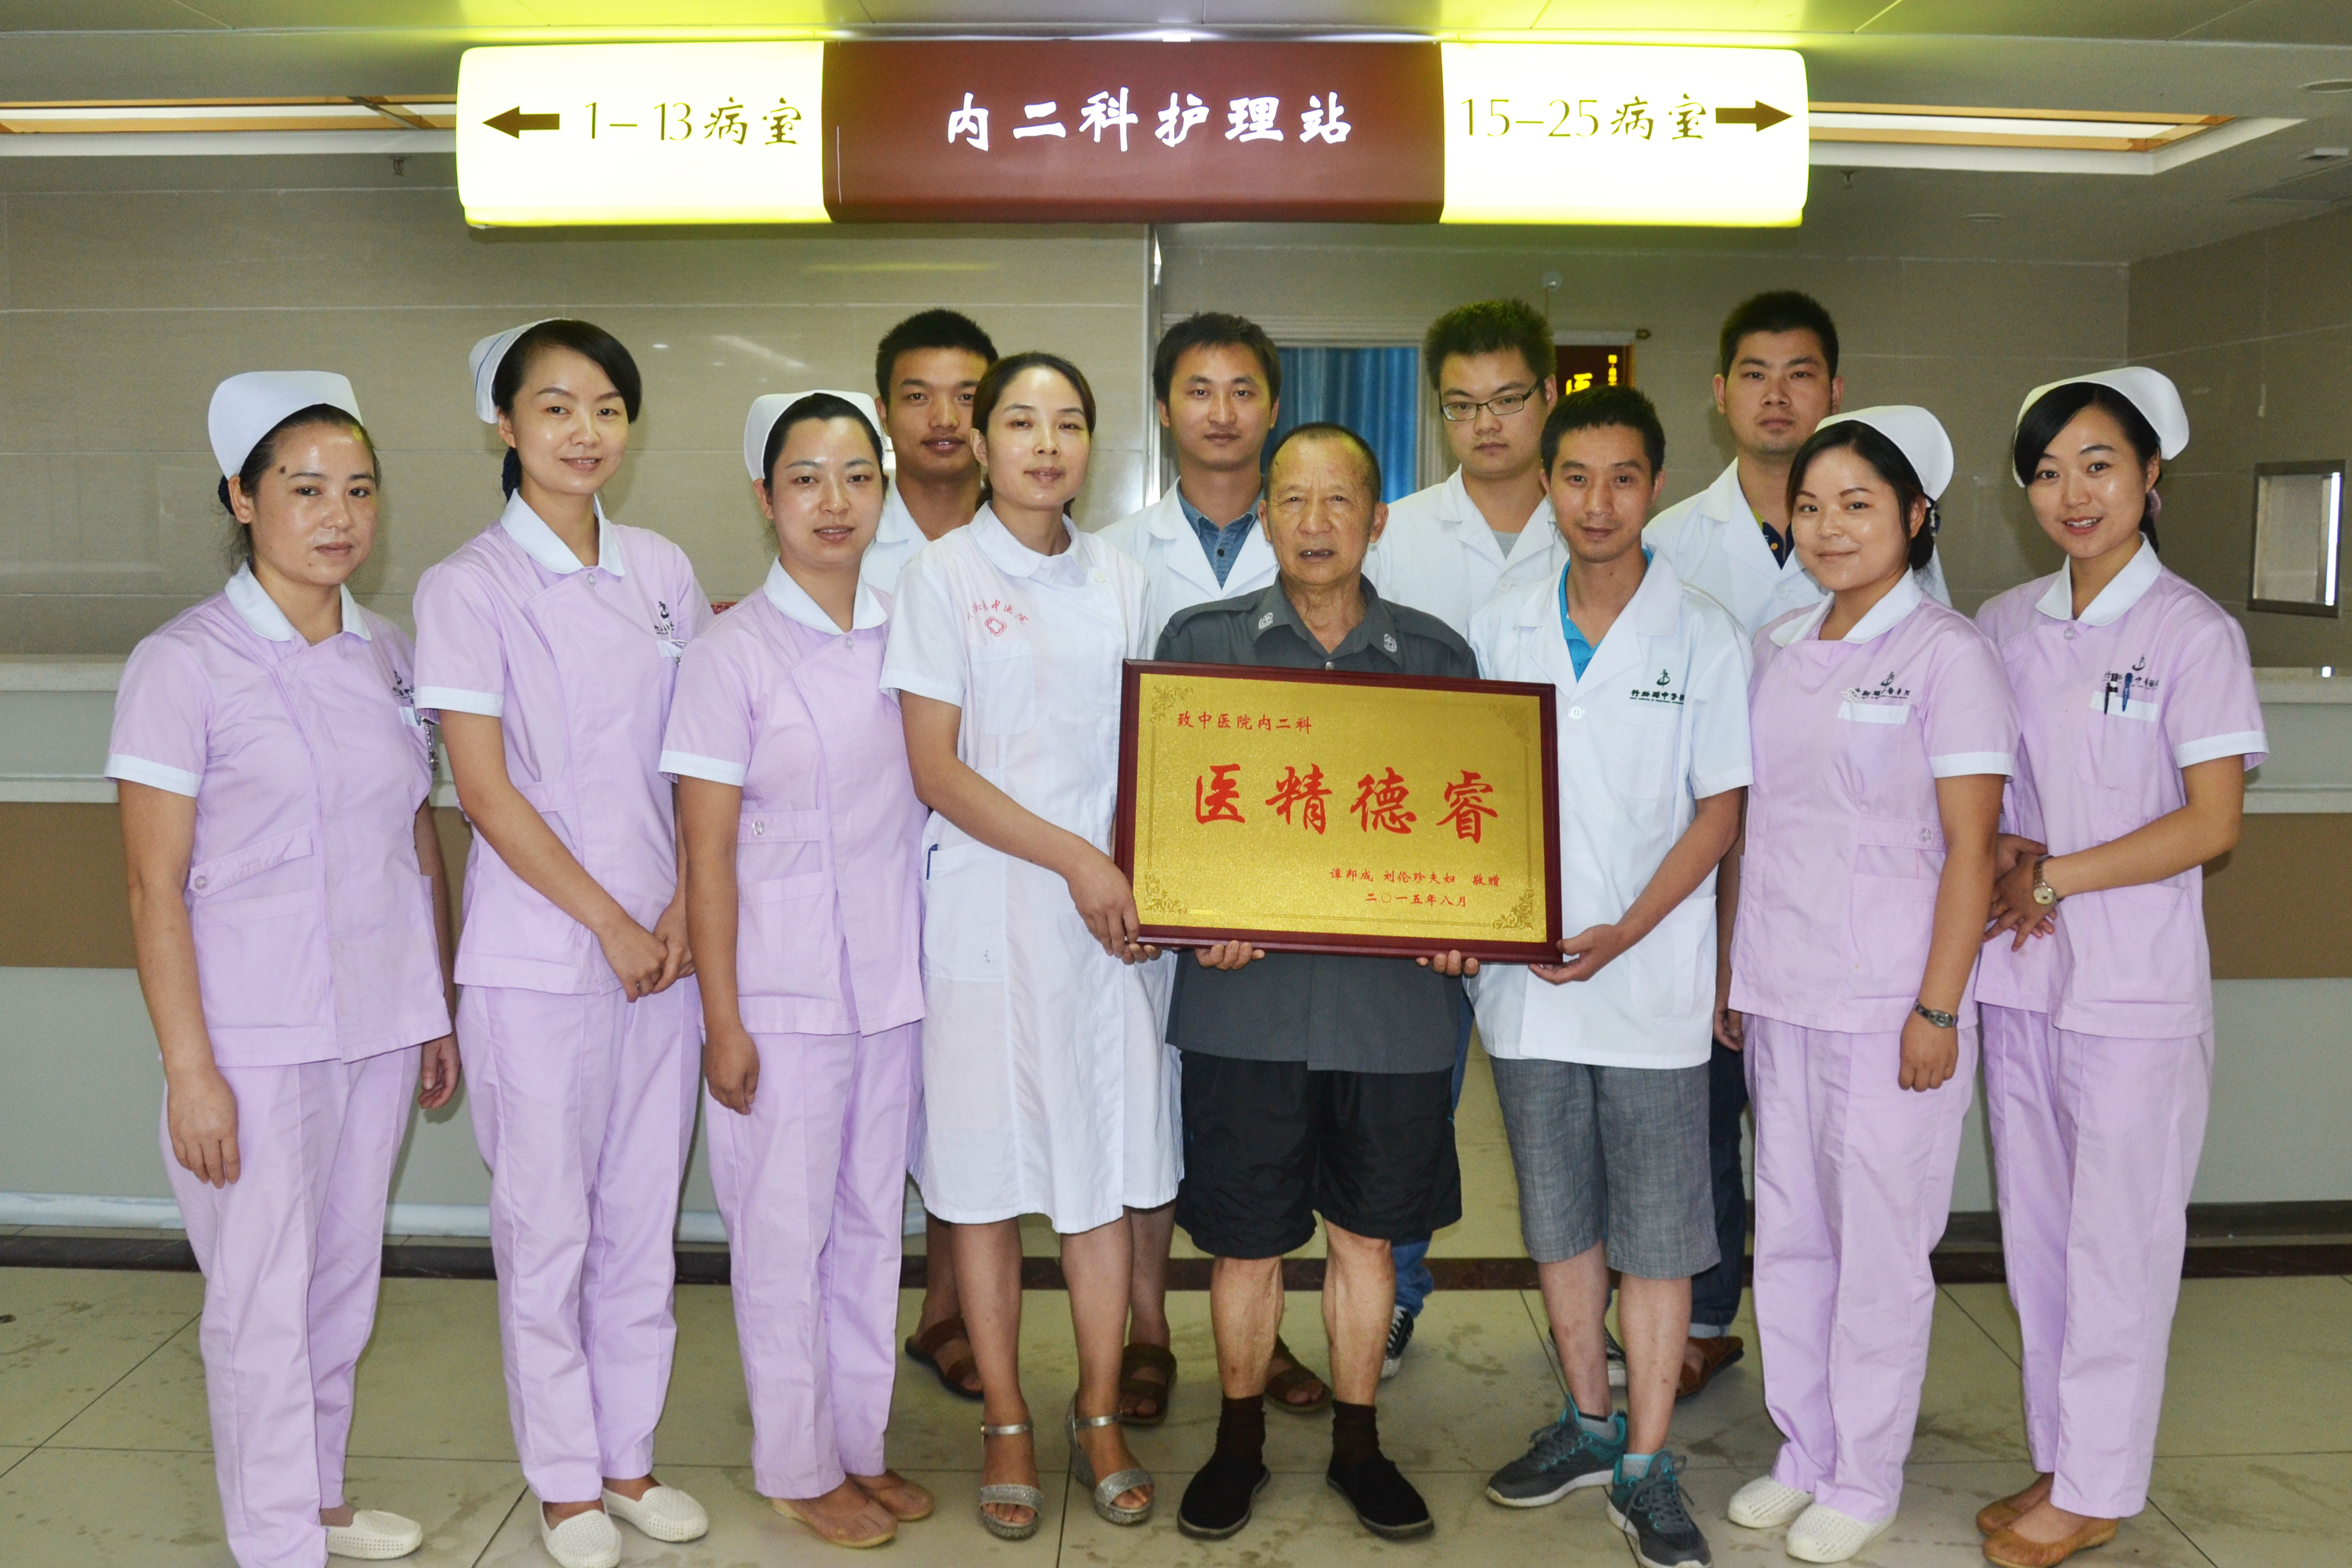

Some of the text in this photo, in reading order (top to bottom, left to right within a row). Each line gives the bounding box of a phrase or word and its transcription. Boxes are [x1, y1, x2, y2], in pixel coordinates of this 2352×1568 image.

[948, 86, 1351, 152] 内二科护理站
[1178, 710, 1312, 735] 致中医院内二科
[1195, 762, 1499, 845] 医精德睿
[1383, 870, 1456, 884] 刘伦珍夫妇
[1472, 873, 1500, 887] 敬赠
